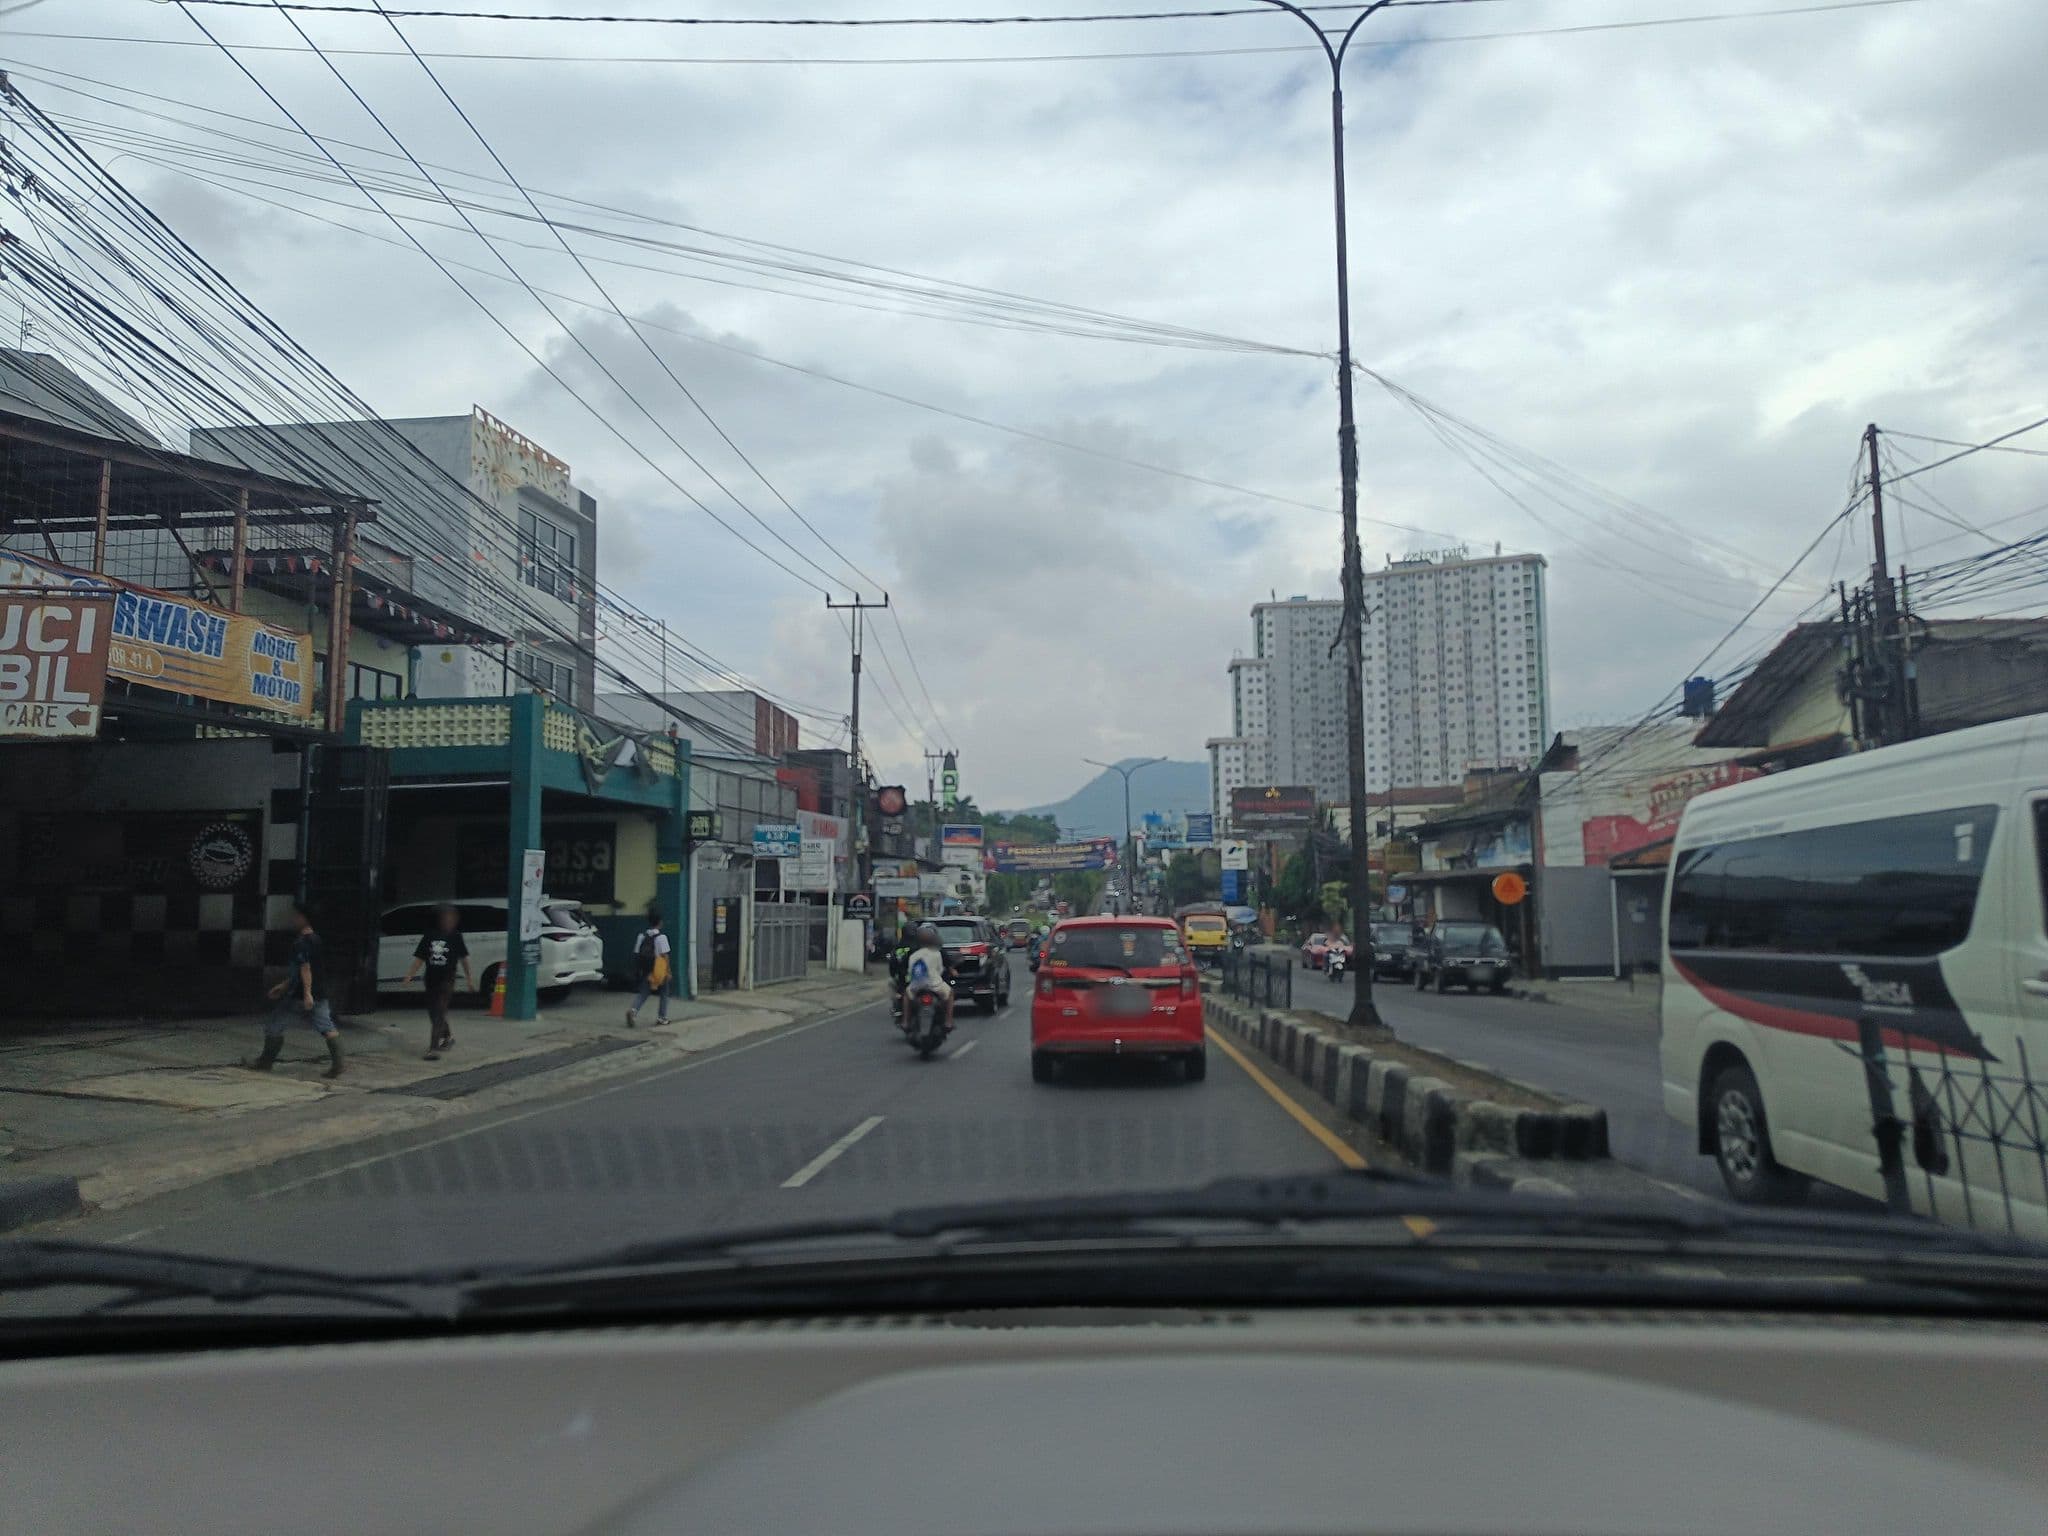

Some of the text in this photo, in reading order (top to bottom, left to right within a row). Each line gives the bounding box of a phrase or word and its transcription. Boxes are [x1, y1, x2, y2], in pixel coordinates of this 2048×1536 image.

[252, 630, 298, 662] MOBIL
[252, 673, 301, 704] MOTOR
[5, 704, 58, 728] CARE
